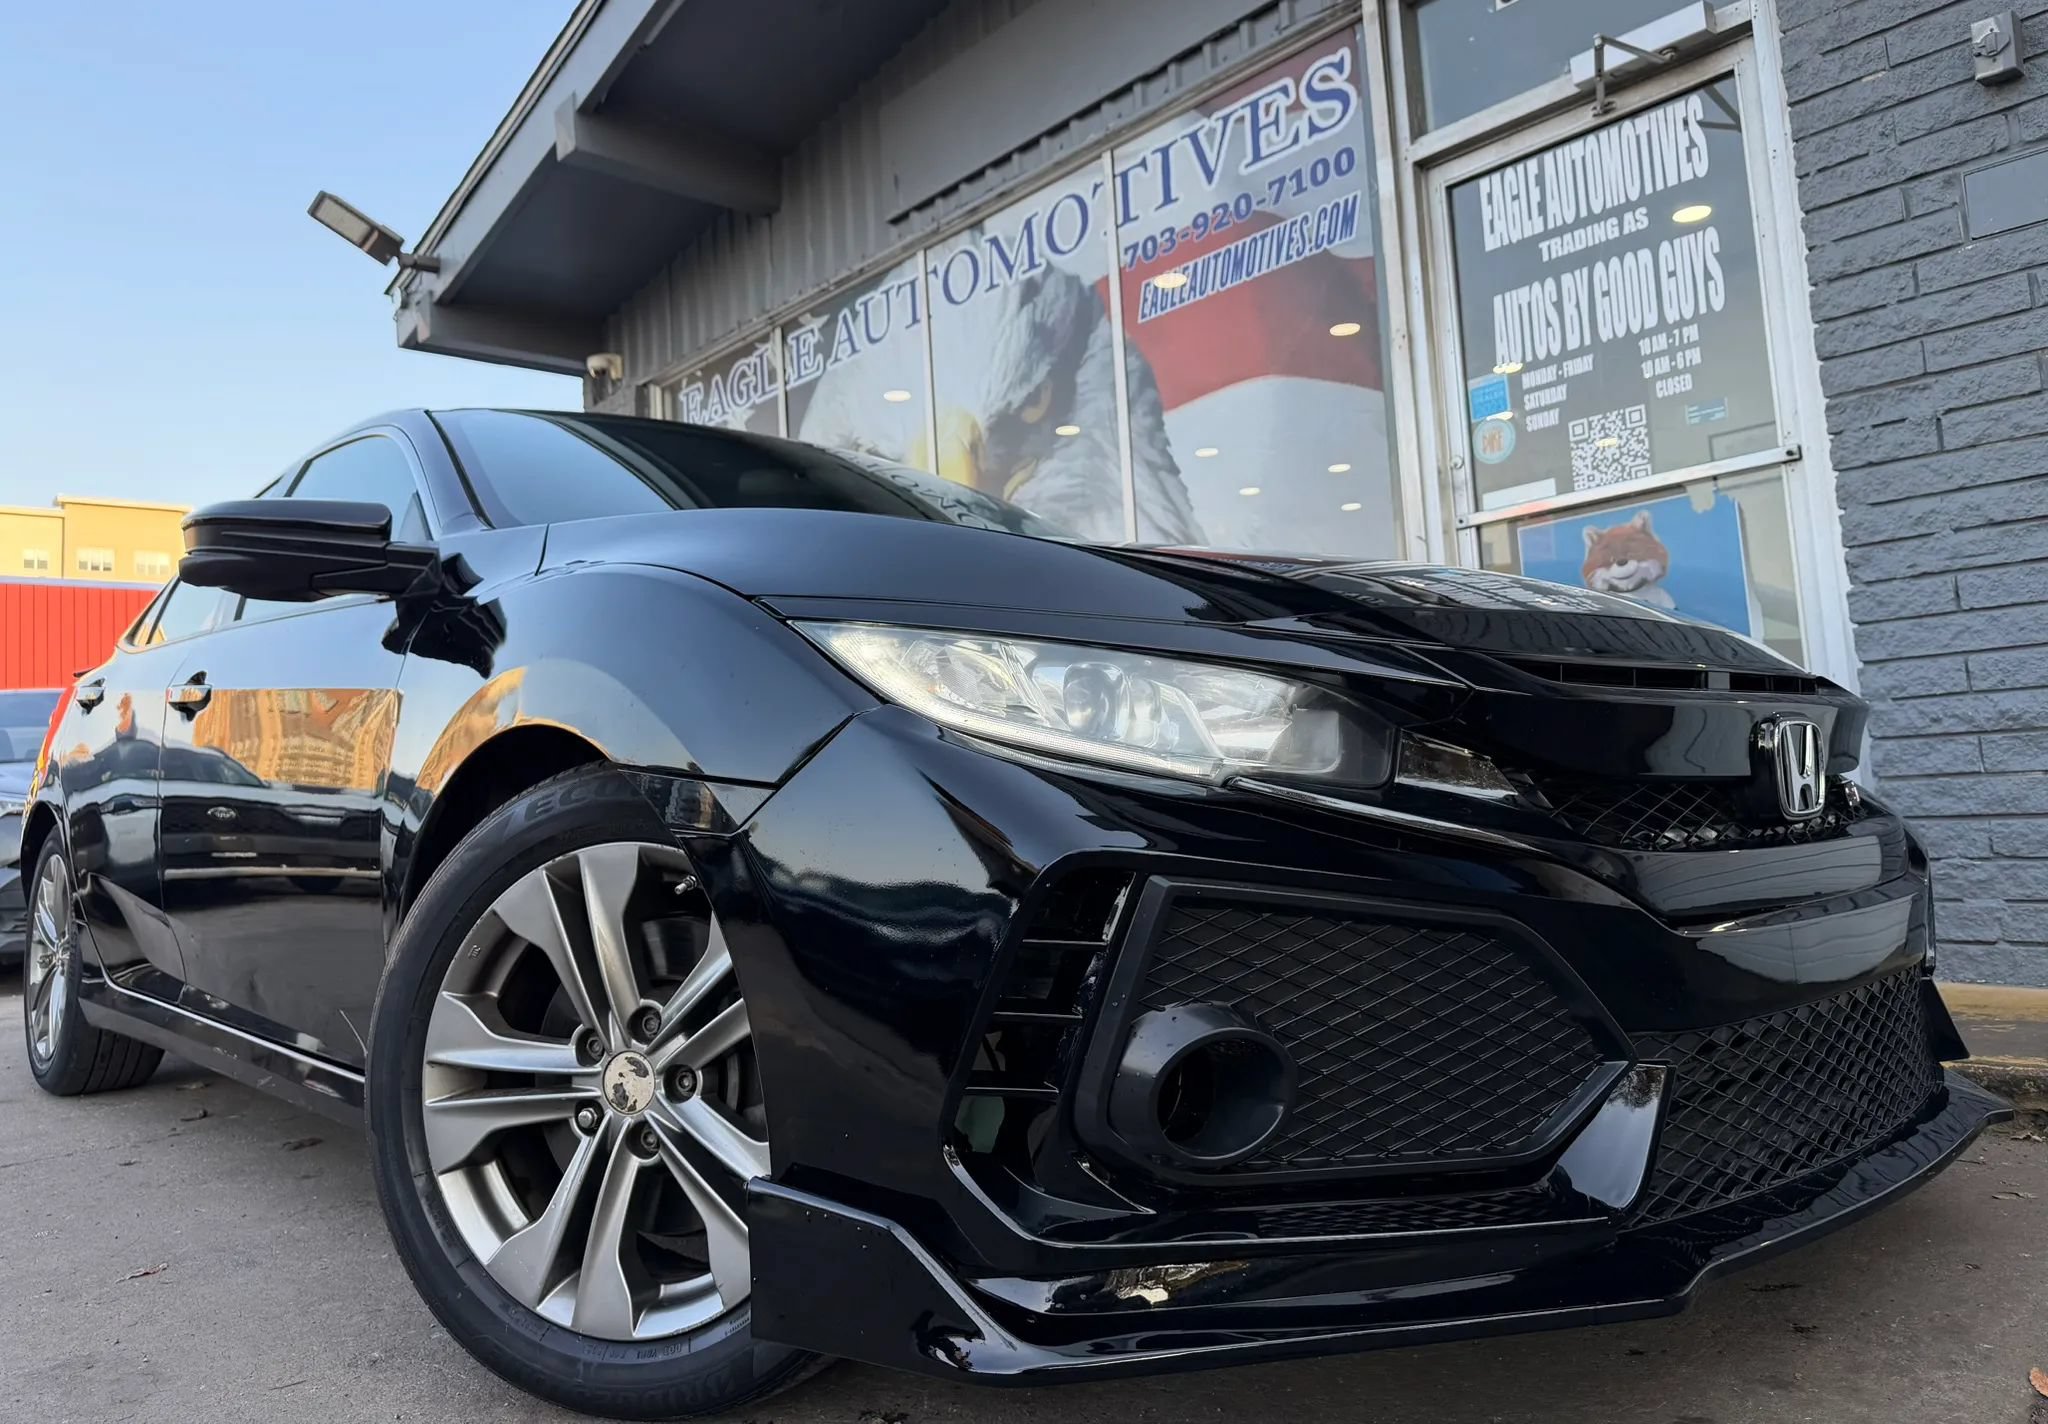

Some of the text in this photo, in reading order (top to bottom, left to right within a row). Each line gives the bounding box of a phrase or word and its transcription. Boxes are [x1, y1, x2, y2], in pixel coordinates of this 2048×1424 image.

[1479, 94, 1709, 252] EAGLE AUTOMOTIVES
[1124, 146, 1356, 270] 703-920-7100
[680, 48, 1356, 425] EAGLE AUTOMOTIVES
[1139, 192, 1360, 321] EAGLEAUTOMOTIVES.COM
[1538, 207, 1649, 262] TRADING AS
[1493, 226, 1725, 369] AUTOS BY GOOD GUYS
[1639, 337, 1652, 357] 10
[1652, 332, 1668, 354] AM
[1672, 327, 1680, 347] 7
[1682, 323, 1700, 344] PM
[1641, 360, 1654, 379] 10
[1654, 355, 1671, 376] AM
[1676, 350, 1684, 370] 6
[1684, 346, 1702, 367] PM
[1522, 363, 1558, 390] MONDAY
[1562, 353, 1594, 379] FRIDAY
[1655, 373, 1693, 399] CLOSED
[1523, 383, 1568, 411] SATURDAY
[1525, 407, 1560, 433] SUNDAY
